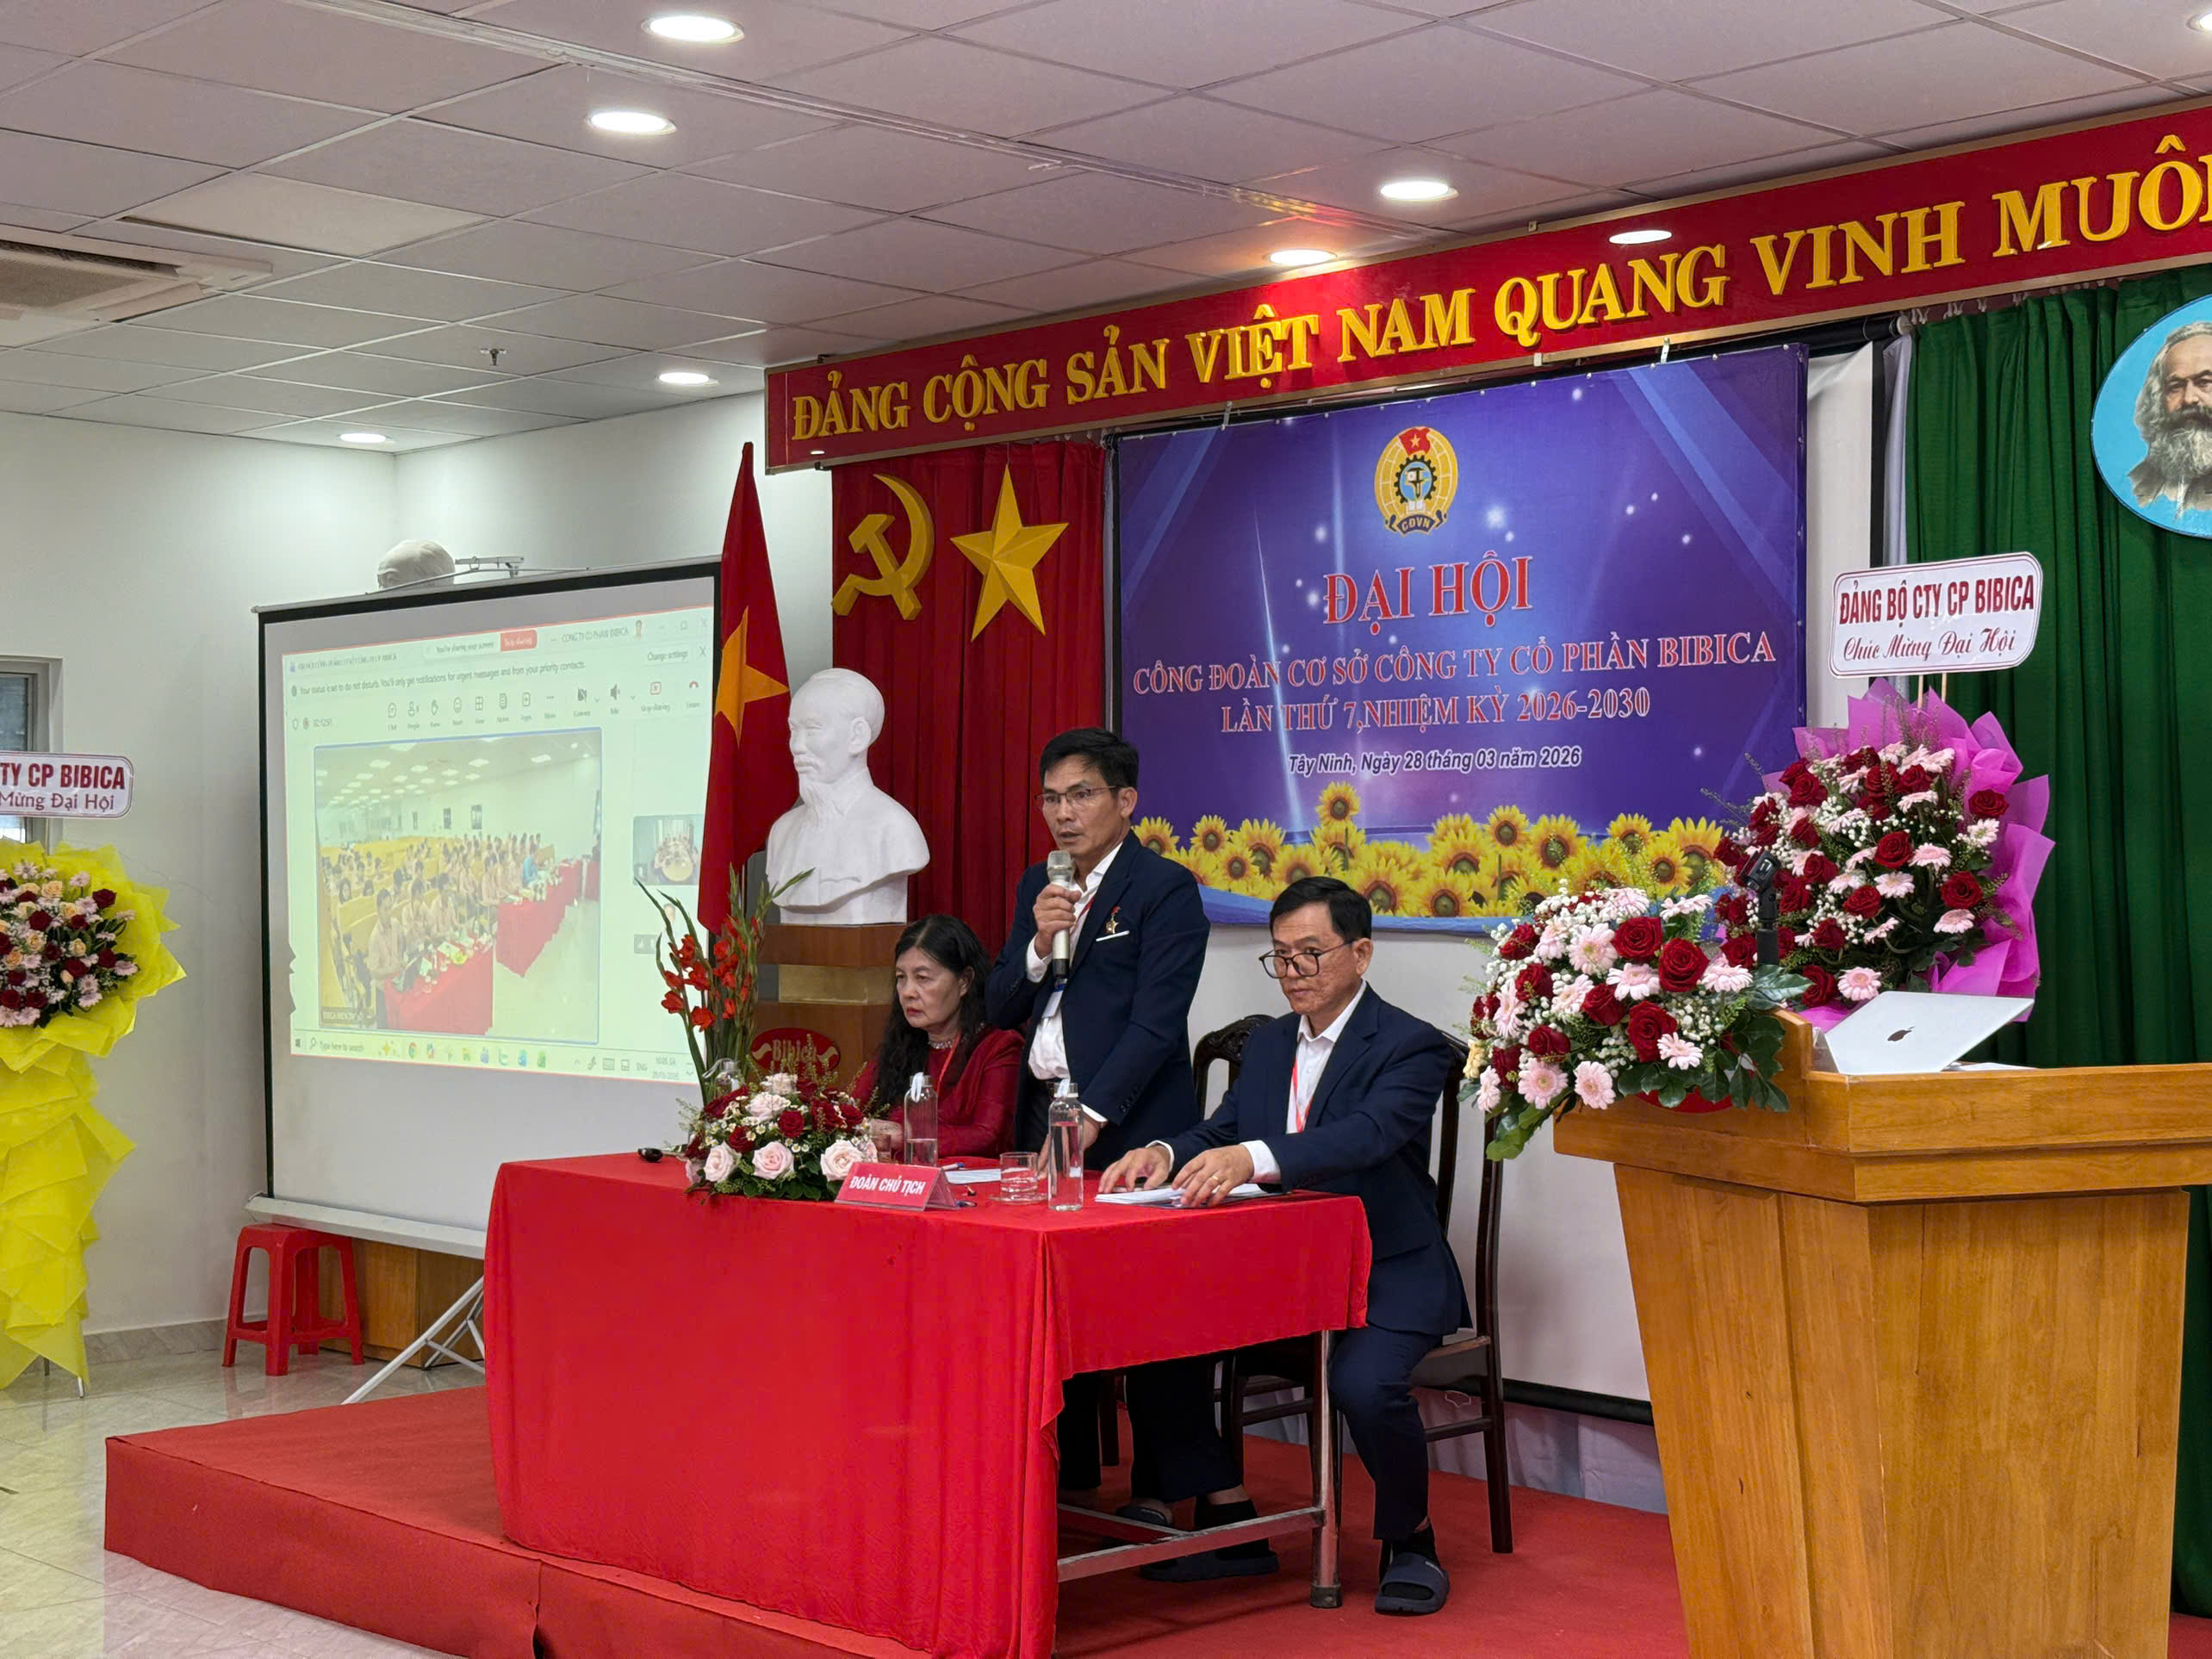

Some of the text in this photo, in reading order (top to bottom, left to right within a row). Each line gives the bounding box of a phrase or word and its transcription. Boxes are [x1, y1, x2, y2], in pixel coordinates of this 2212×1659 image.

[792, 134, 2212, 441] ĐẢNG CỘNG SẢN VIỆT NAM QUANG VINH MUÔ
[1323, 550, 1533, 635] ĐẠI HỘI
[1840, 575, 2035, 627] ĐẢNG BỘ CTY CP BIBICA
[1133, 631, 1776, 695] CÔNG ĐOÀN CƠ SỞ CÔNG TY CỔ PHẦN BIBICA
[1843, 627, 2016, 662] Chúc Mừng Đại Hội
[1221, 698, 1273, 733] LẦN
[1280, 694, 1339, 731] THỨ
[1466, 685, 1510, 725] KỲ
[1517, 687, 1650, 723] 2026-2030
[28, 763, 54, 787] CP
[60, 765, 125, 790] BIBICA
[1289, 746, 1582, 777] Tây Ninh, Ngày 28 tháng 03 năm 2026
[0, 792, 115, 812] Mừng Đại Hội
